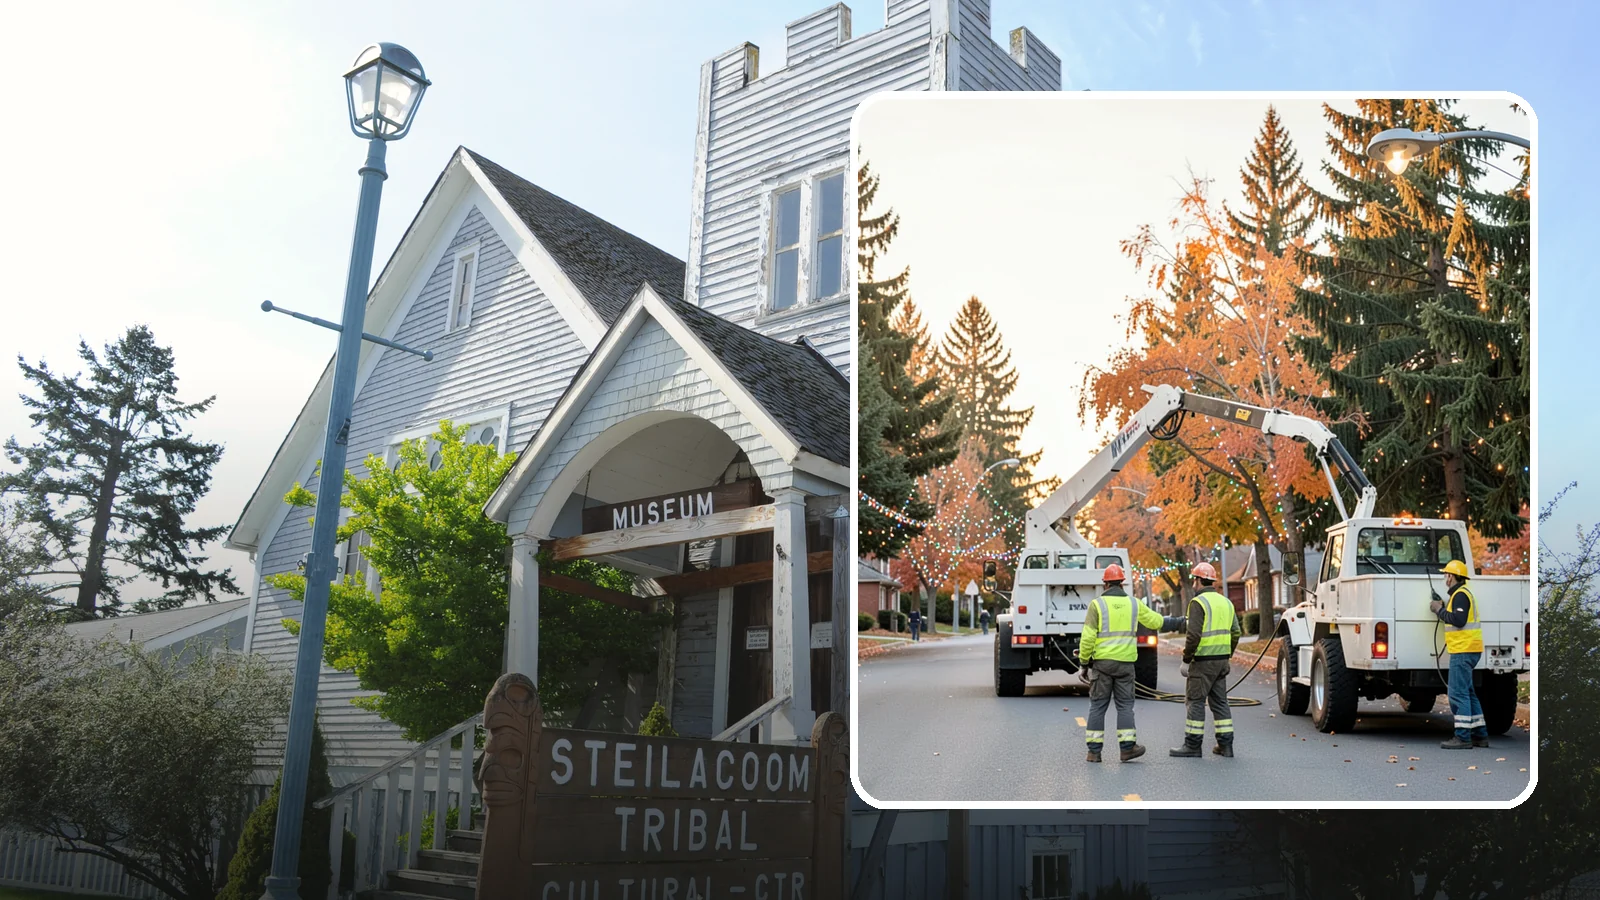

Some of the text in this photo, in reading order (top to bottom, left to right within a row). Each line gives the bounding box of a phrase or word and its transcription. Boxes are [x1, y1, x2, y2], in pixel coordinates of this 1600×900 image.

[613, 491, 713, 530] MUSEUM
[550, 738, 809, 792] STEILACOOM
[615, 806, 758, 852] TRIBAL
